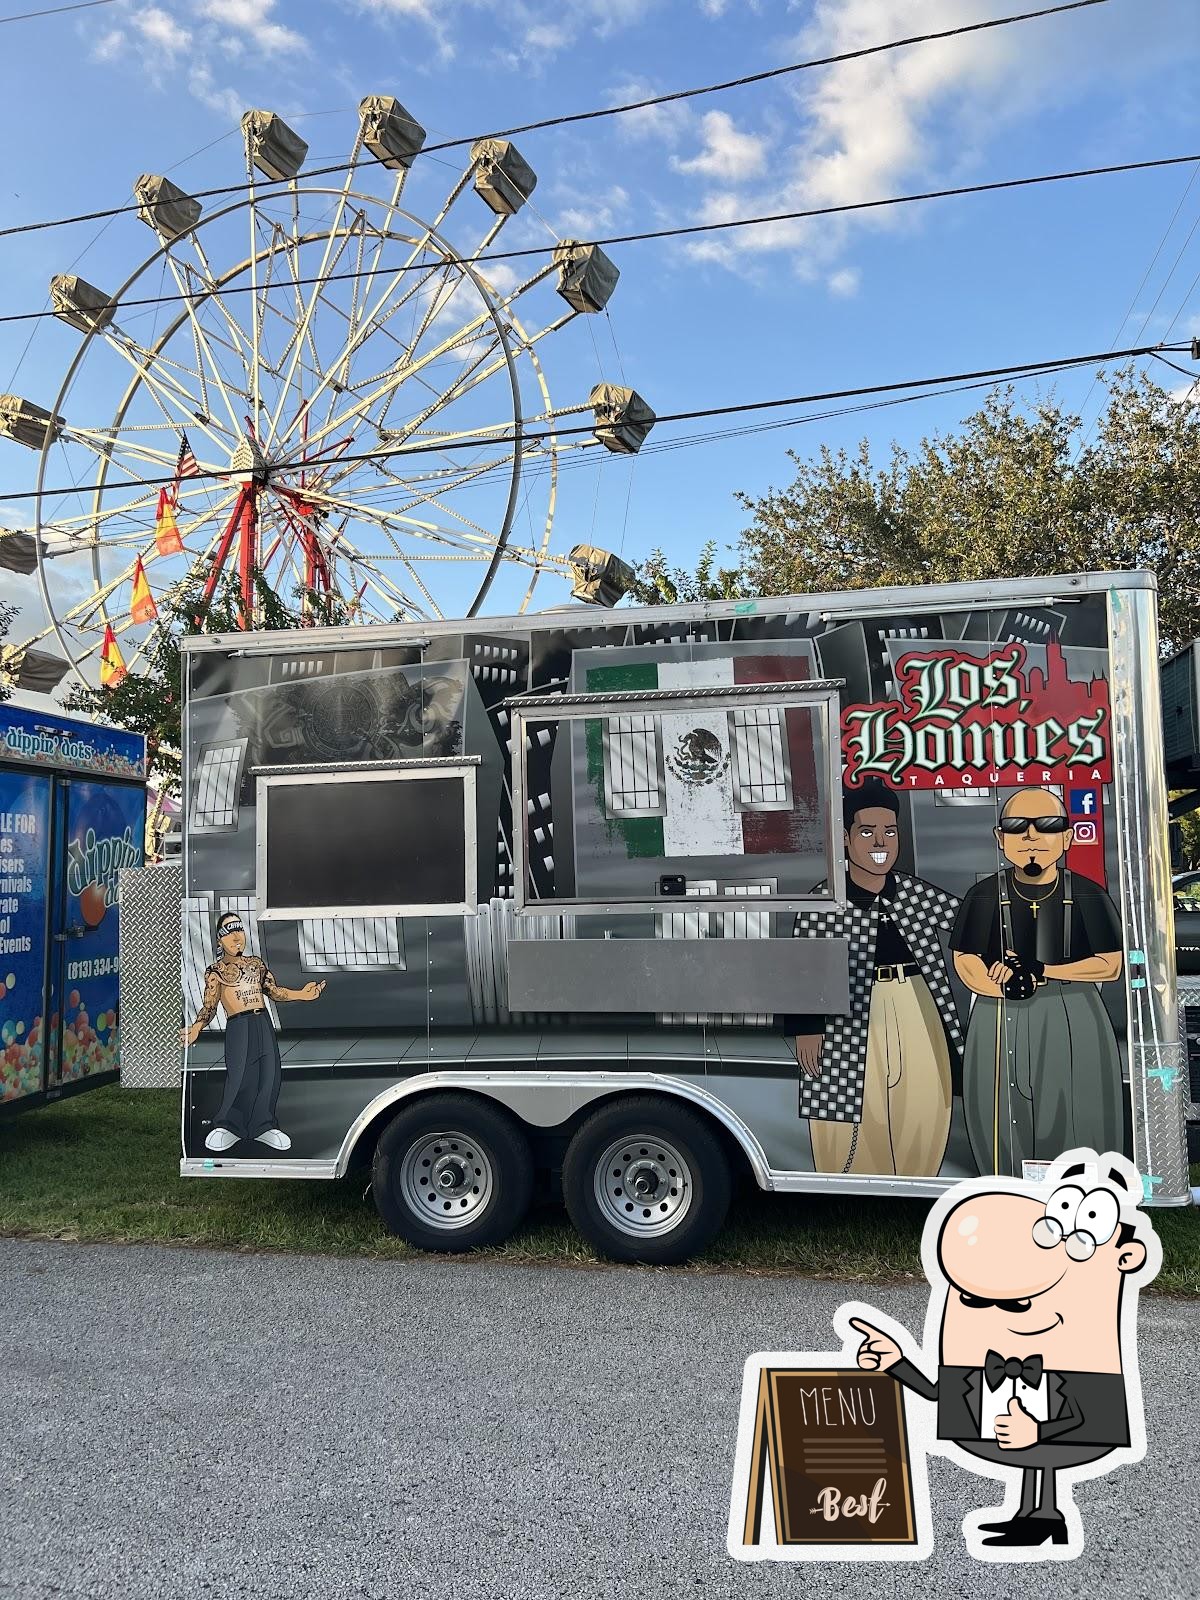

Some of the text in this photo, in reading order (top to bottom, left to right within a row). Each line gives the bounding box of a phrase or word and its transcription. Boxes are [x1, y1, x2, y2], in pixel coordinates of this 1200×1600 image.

[903, 650, 1019, 724] Los
[61, 736, 93, 760] dots
[846, 703, 1106, 784] Homies
[909, 769, 1102, 786] TAQUERIA
[15, 812, 37, 834] FOR
[67, 959, 92, 980] (813)
